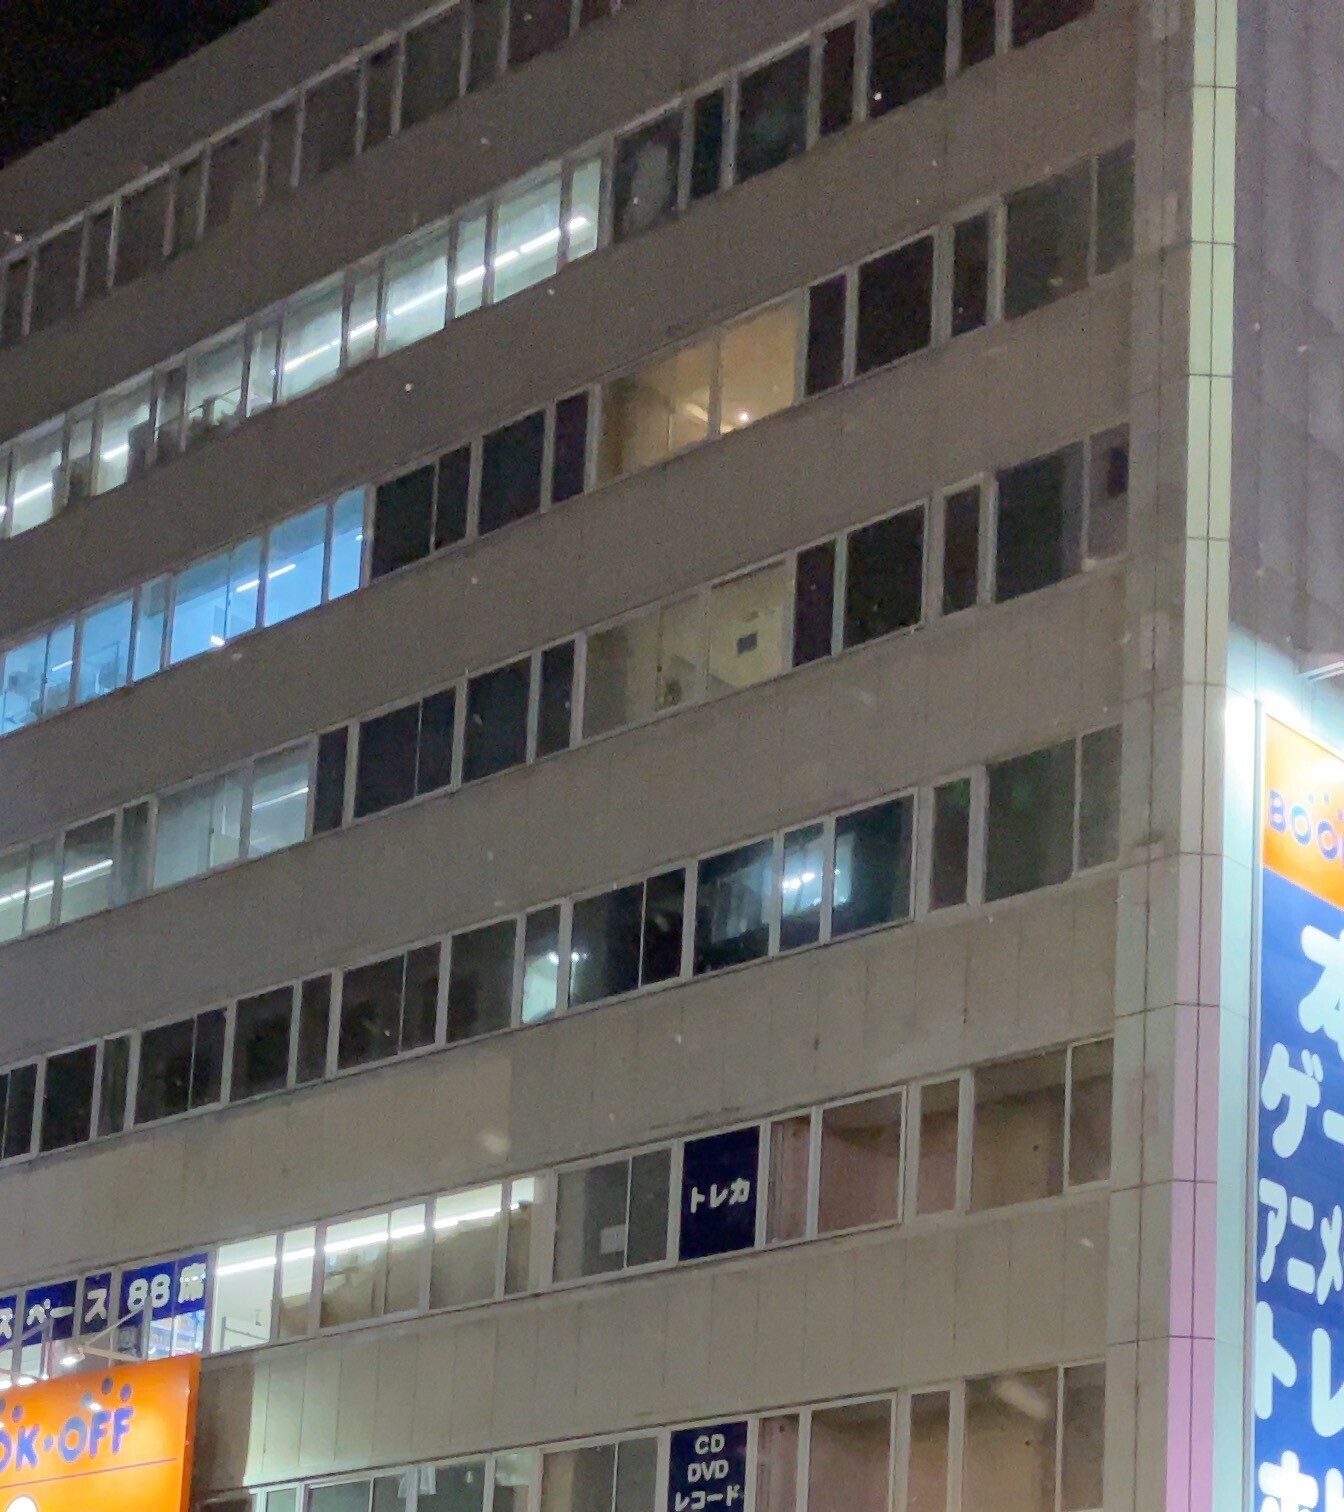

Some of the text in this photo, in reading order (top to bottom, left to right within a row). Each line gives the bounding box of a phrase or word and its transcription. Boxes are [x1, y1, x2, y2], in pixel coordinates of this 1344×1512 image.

[690, 1178, 750, 1214] トレカ
[695, 1434, 725, 1455] CD
[687, 1459, 729, 1483] DVD
[674, 1484, 740, 1512] レコード
